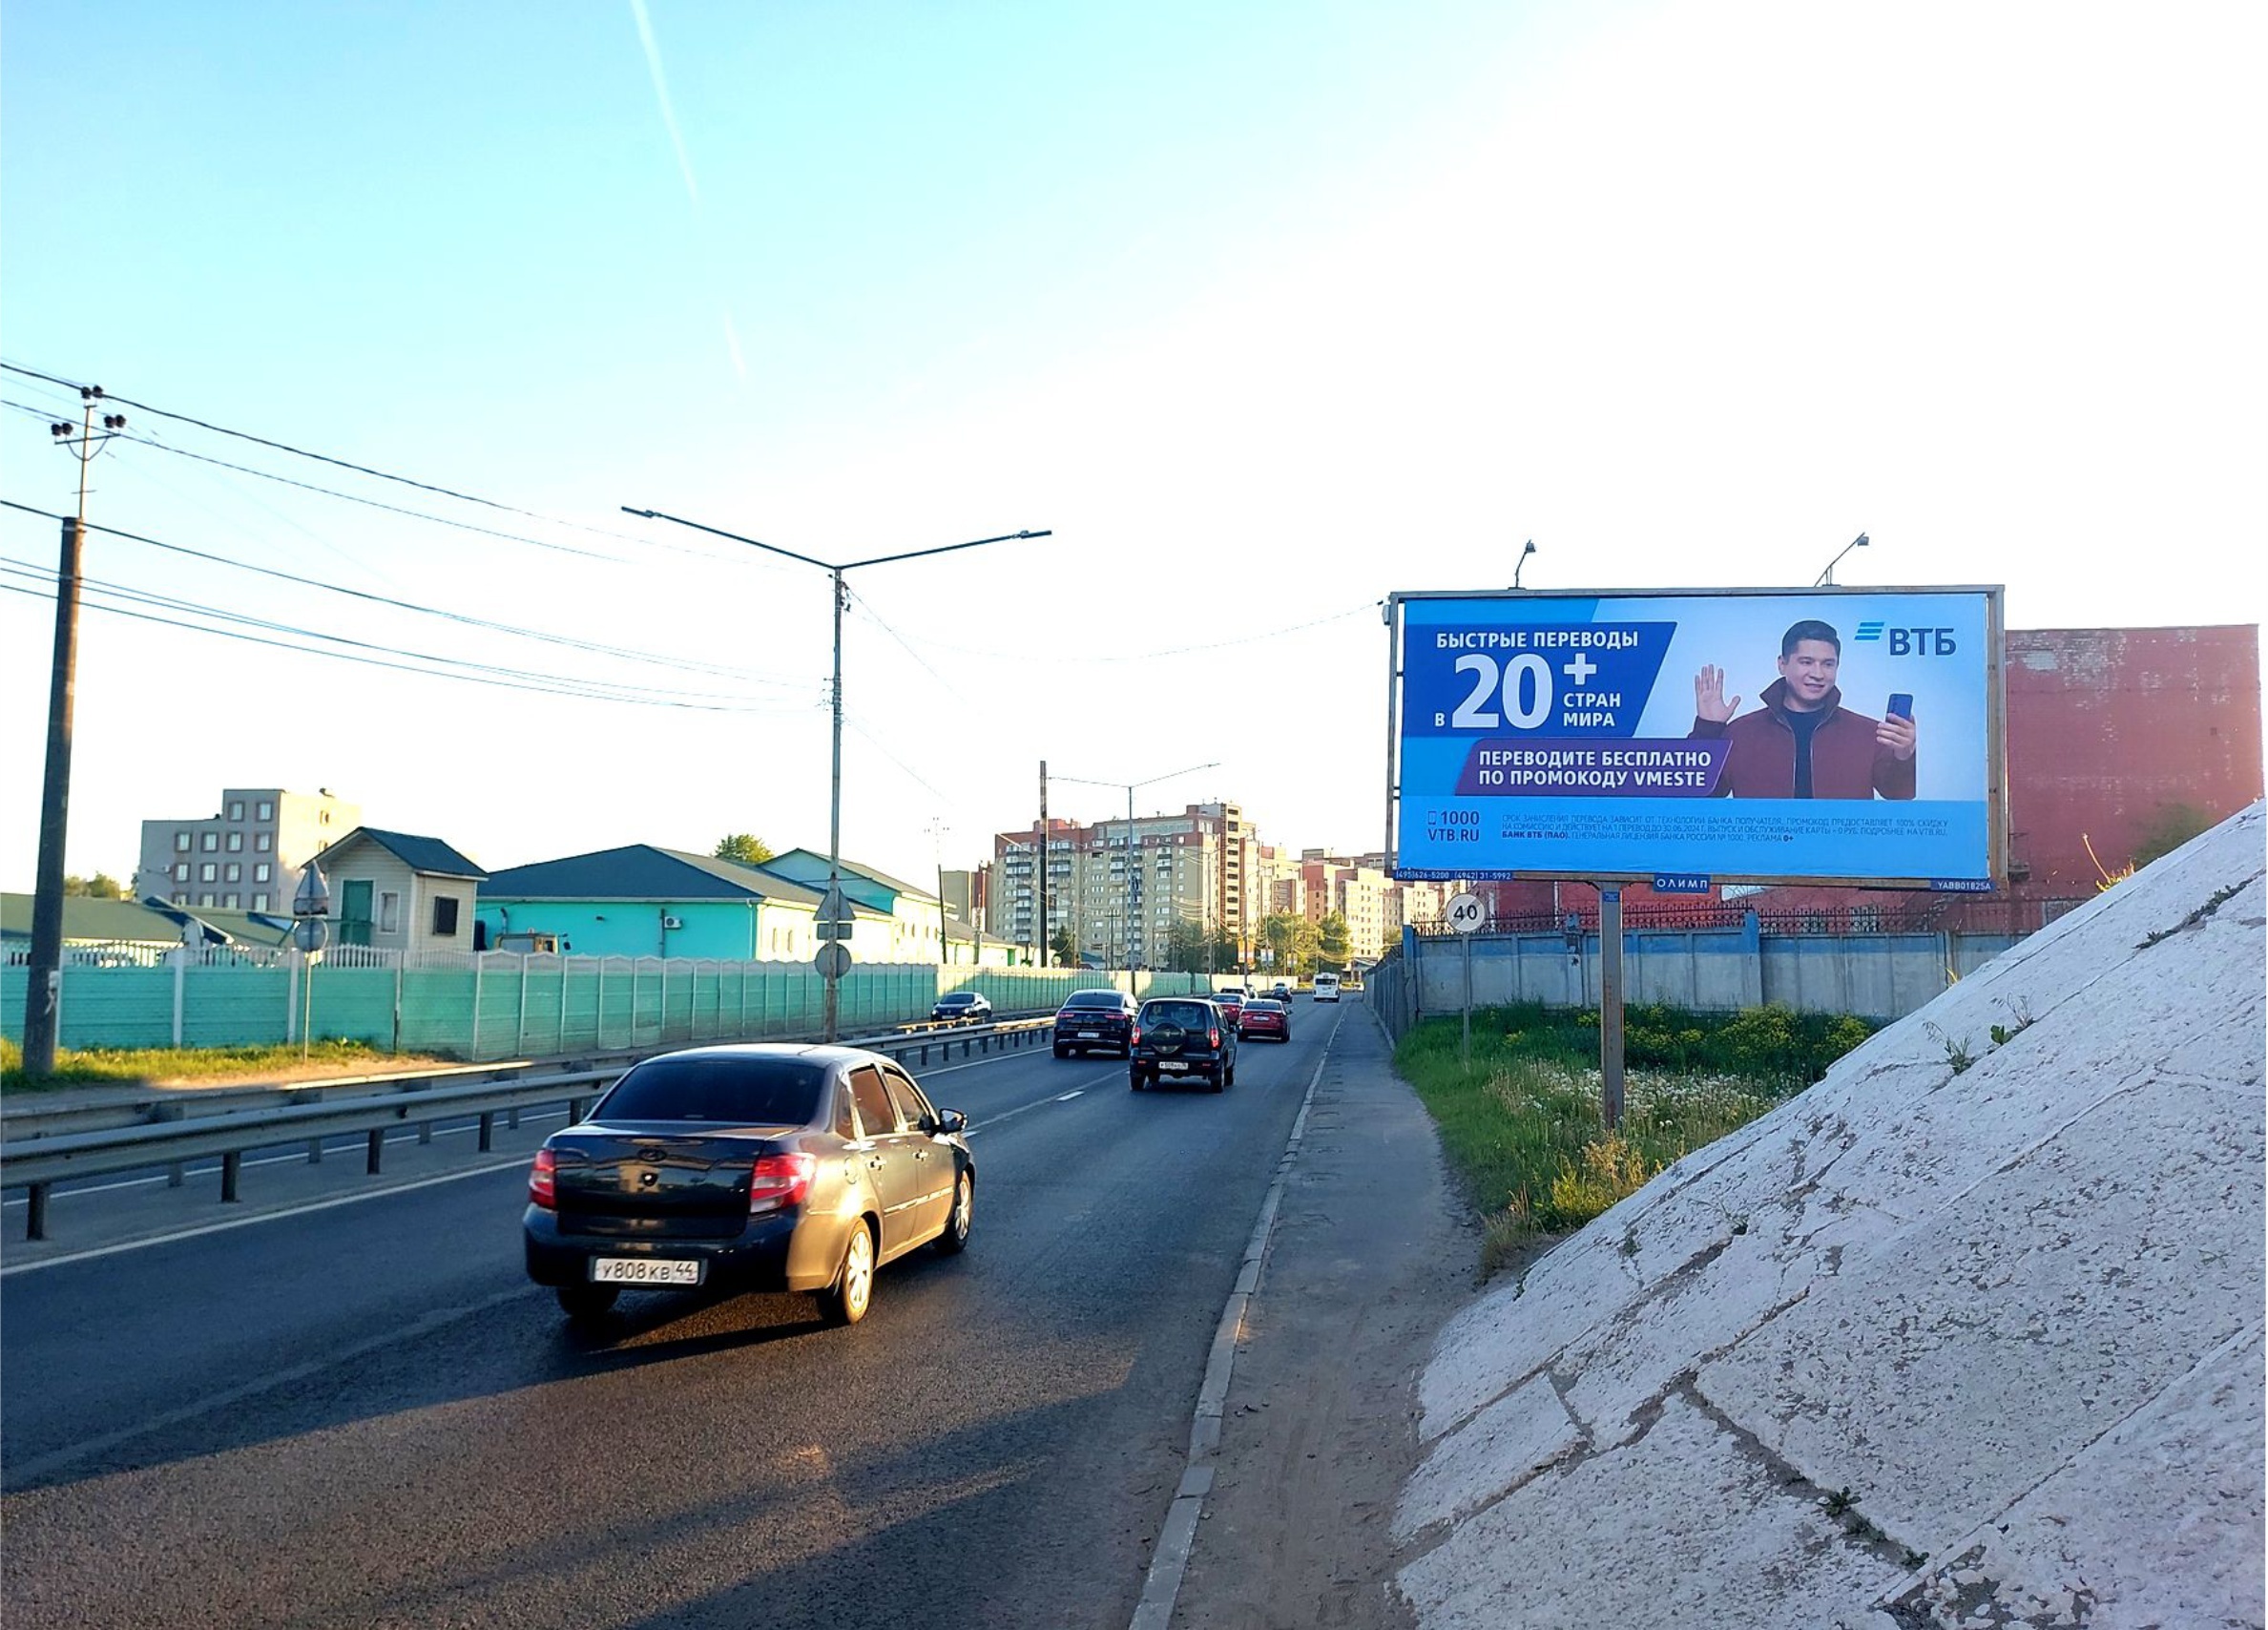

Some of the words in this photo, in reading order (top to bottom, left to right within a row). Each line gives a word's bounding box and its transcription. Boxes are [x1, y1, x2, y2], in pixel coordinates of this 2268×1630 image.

[1436, 633, 1527, 648] БЫСТРЫЕ
[1533, 631, 1638, 649] ПЕРЕВОДЫ
[1890, 628, 1956, 655] ВТБ
[1563, 693, 1621, 707] СТРАН
[1563, 713, 1614, 726] МИРА
[1479, 751, 1595, 767] ПЕРЕВОДИТЕ
[1601, 751, 1712, 766] БЕСПЛАТНО
[1479, 770, 1504, 784] ПО
[1510, 770, 1628, 787] ПРОМОКОДУ
[1633, 771, 1706, 786] VMESTE
[1441, 810, 1480, 825] 1000
[1427, 828, 1480, 841] VTB.RU
[1656, 878, 1707, 888] ОЛИМП
[1453, 905, 1478, 921] 40
